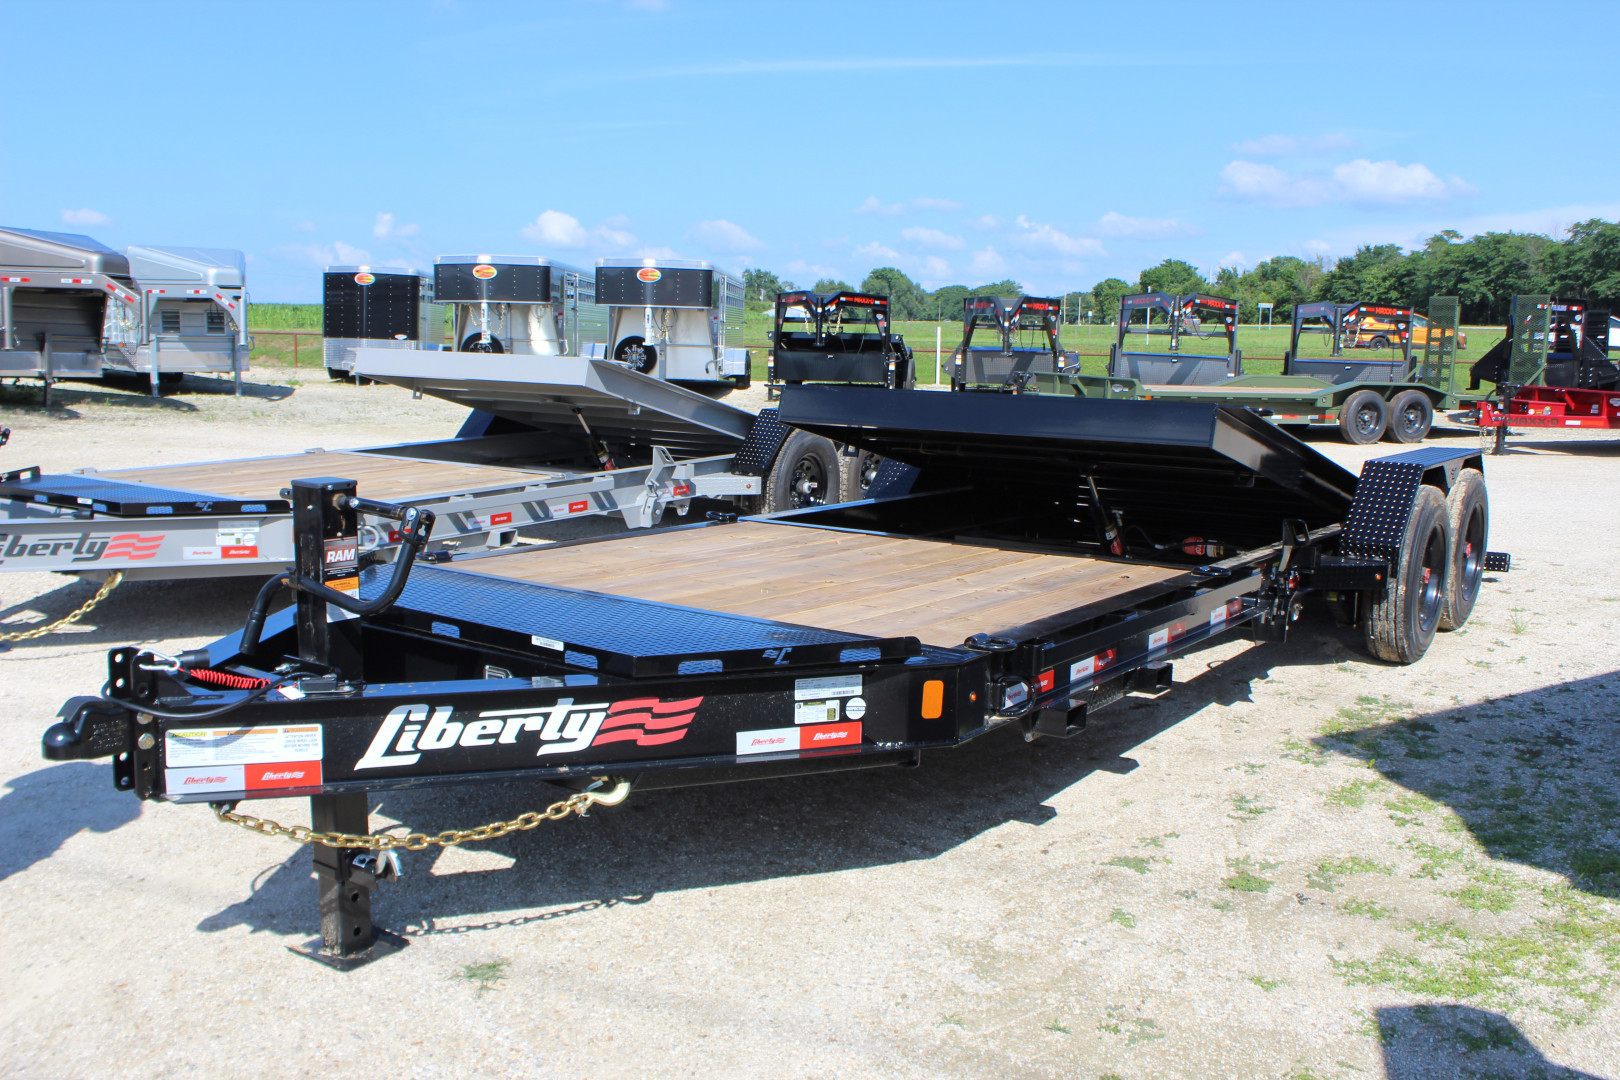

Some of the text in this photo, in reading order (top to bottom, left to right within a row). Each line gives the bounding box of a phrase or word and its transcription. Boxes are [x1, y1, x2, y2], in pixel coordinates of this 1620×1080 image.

[1507, 416, 1559, 426] MAXX-D
[0, 532, 111, 566] berty
[326, 548, 356, 564] RAM
[354, 697, 610, 771] Liberty
[183, 776, 215, 785] Liberty
[261, 771, 293, 781] Liberty
